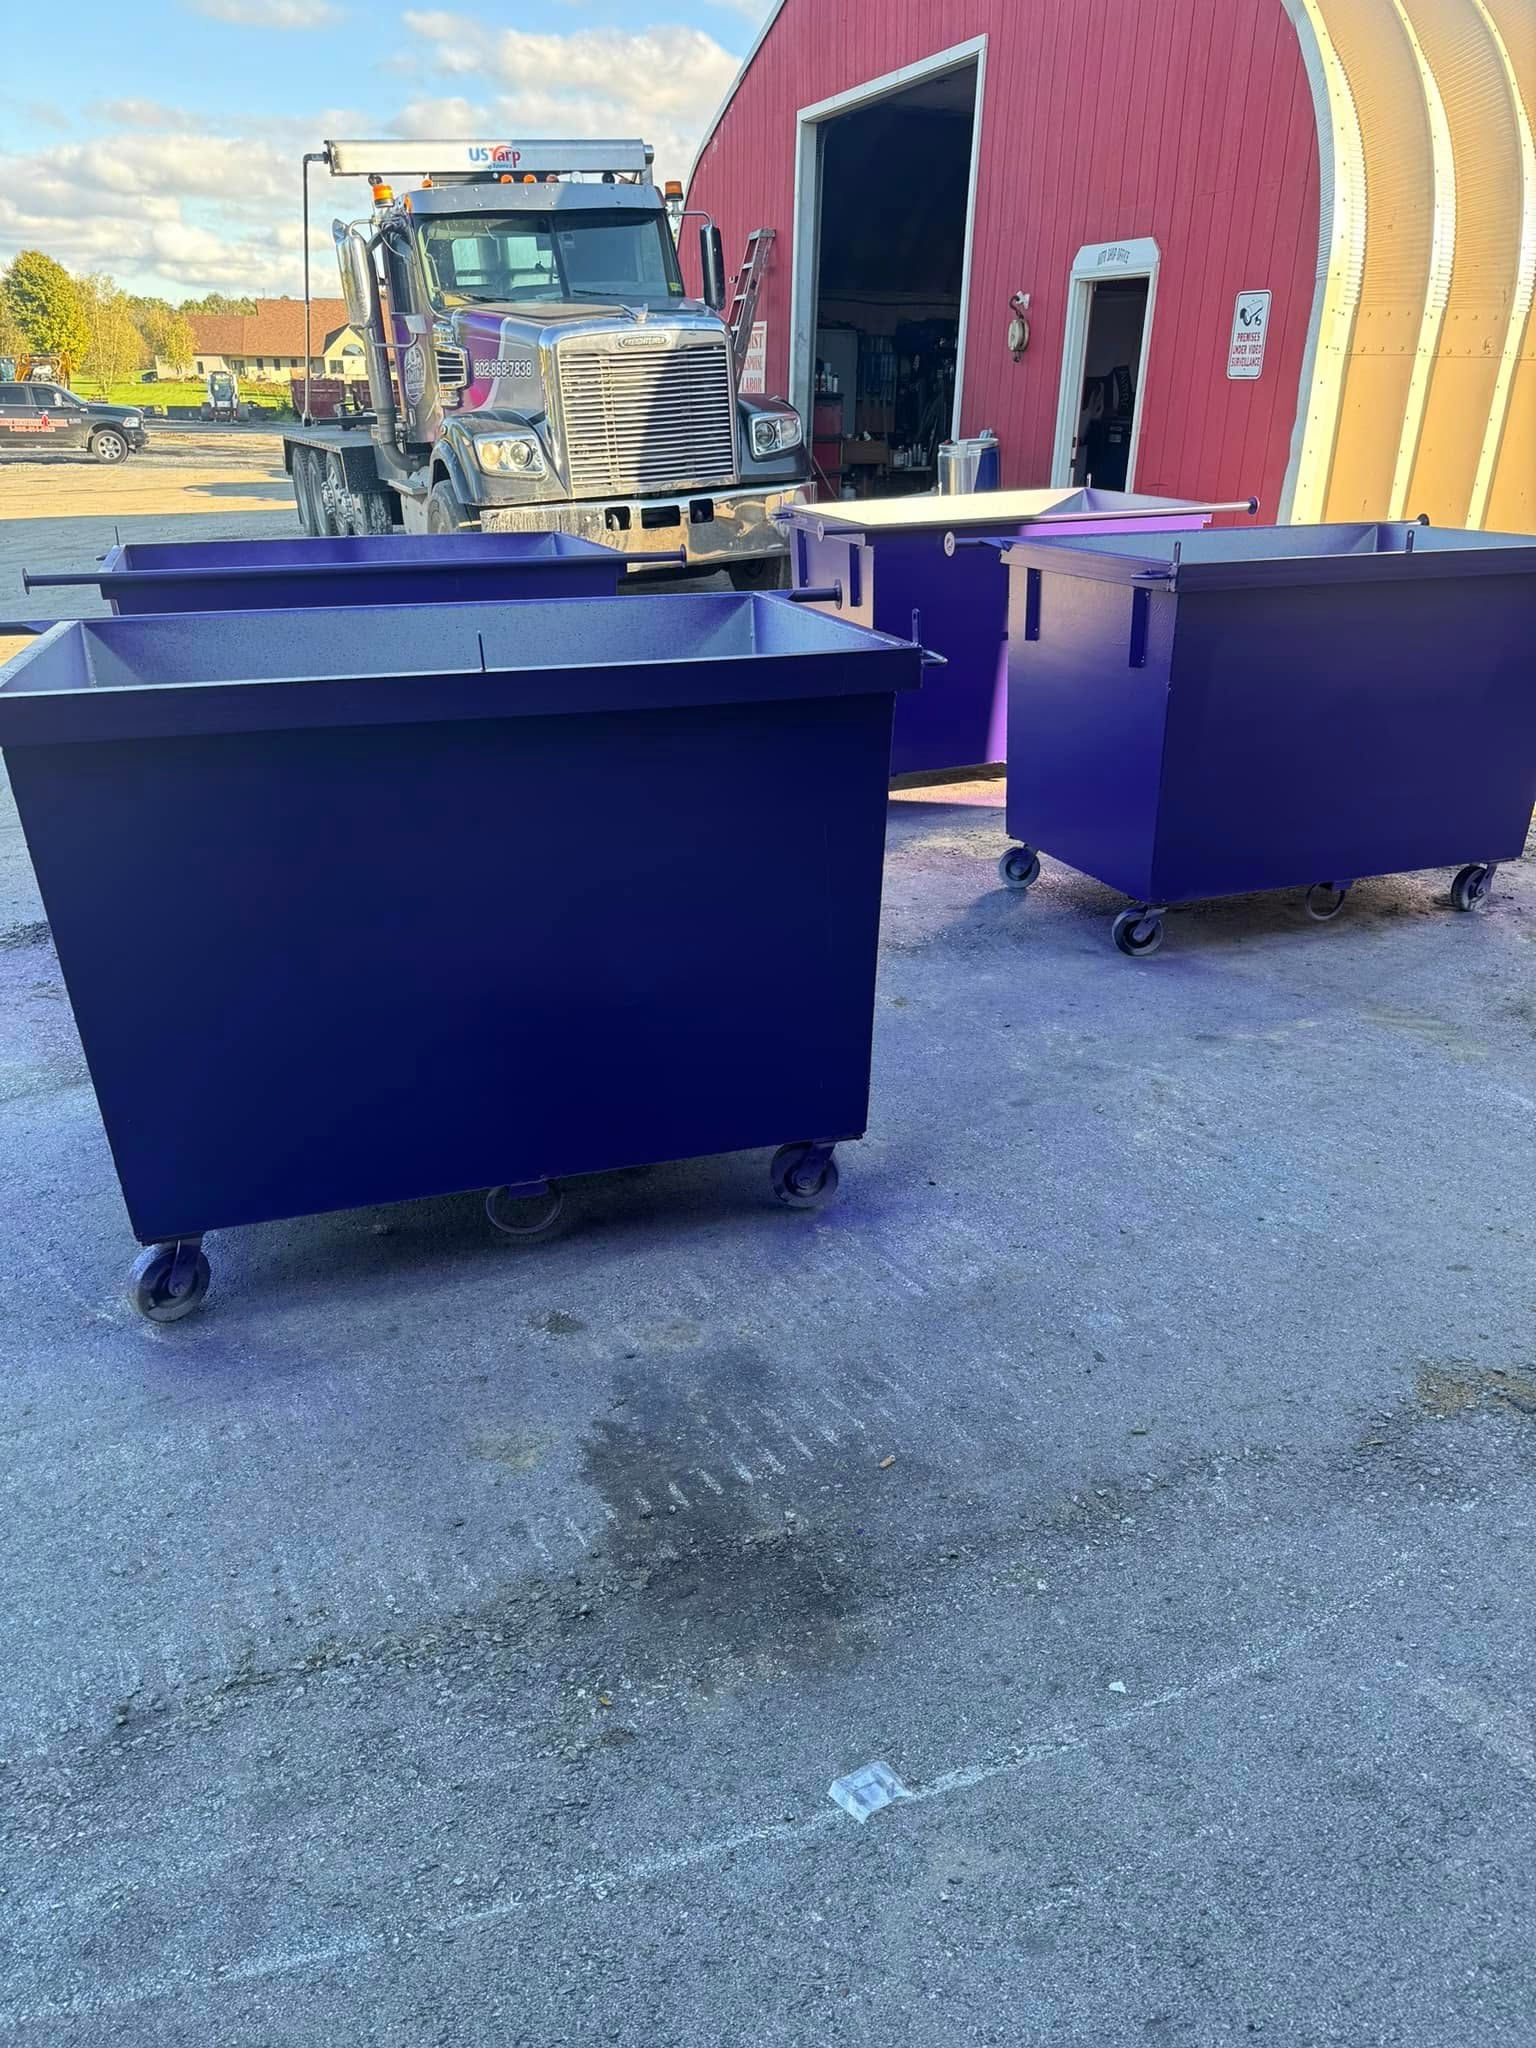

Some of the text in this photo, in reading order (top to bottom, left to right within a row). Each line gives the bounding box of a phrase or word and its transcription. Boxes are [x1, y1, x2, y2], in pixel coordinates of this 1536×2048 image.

[469, 145, 521, 169] US Tarp
[1236, 331, 1262, 343] PREMISES
[1232, 343, 1262, 355] UNDER VIDEO
[1230, 356, 1261, 368] SURVEILLANCE
[474, 359, 532, 379] 802-868-7838
[742, 378, 762, 393] LABOR
